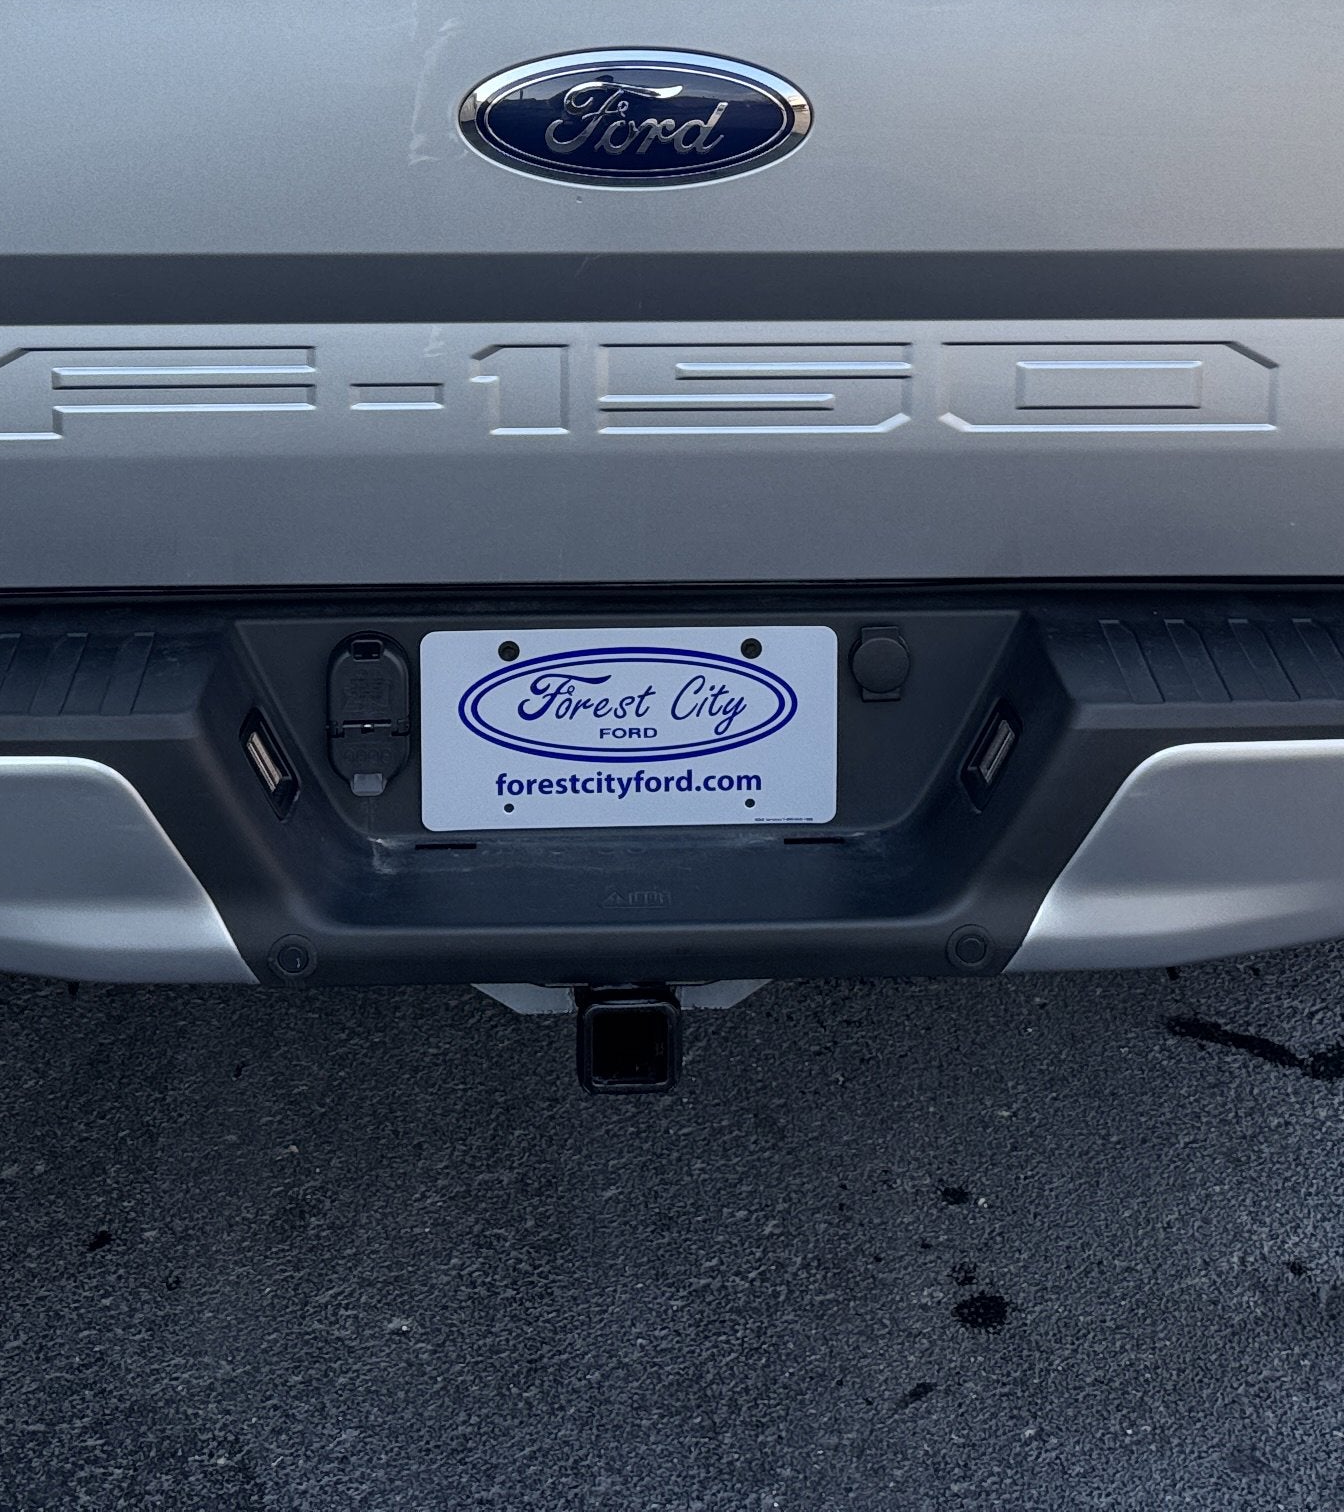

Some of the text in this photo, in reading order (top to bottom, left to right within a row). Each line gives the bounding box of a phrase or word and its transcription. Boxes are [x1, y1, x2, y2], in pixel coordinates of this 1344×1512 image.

[545, 81, 729, 155] Ford
[517, 673, 748, 736] Forest City
[599, 727, 658, 739] FORD
[495, 769, 762, 799] forestcityford.com
